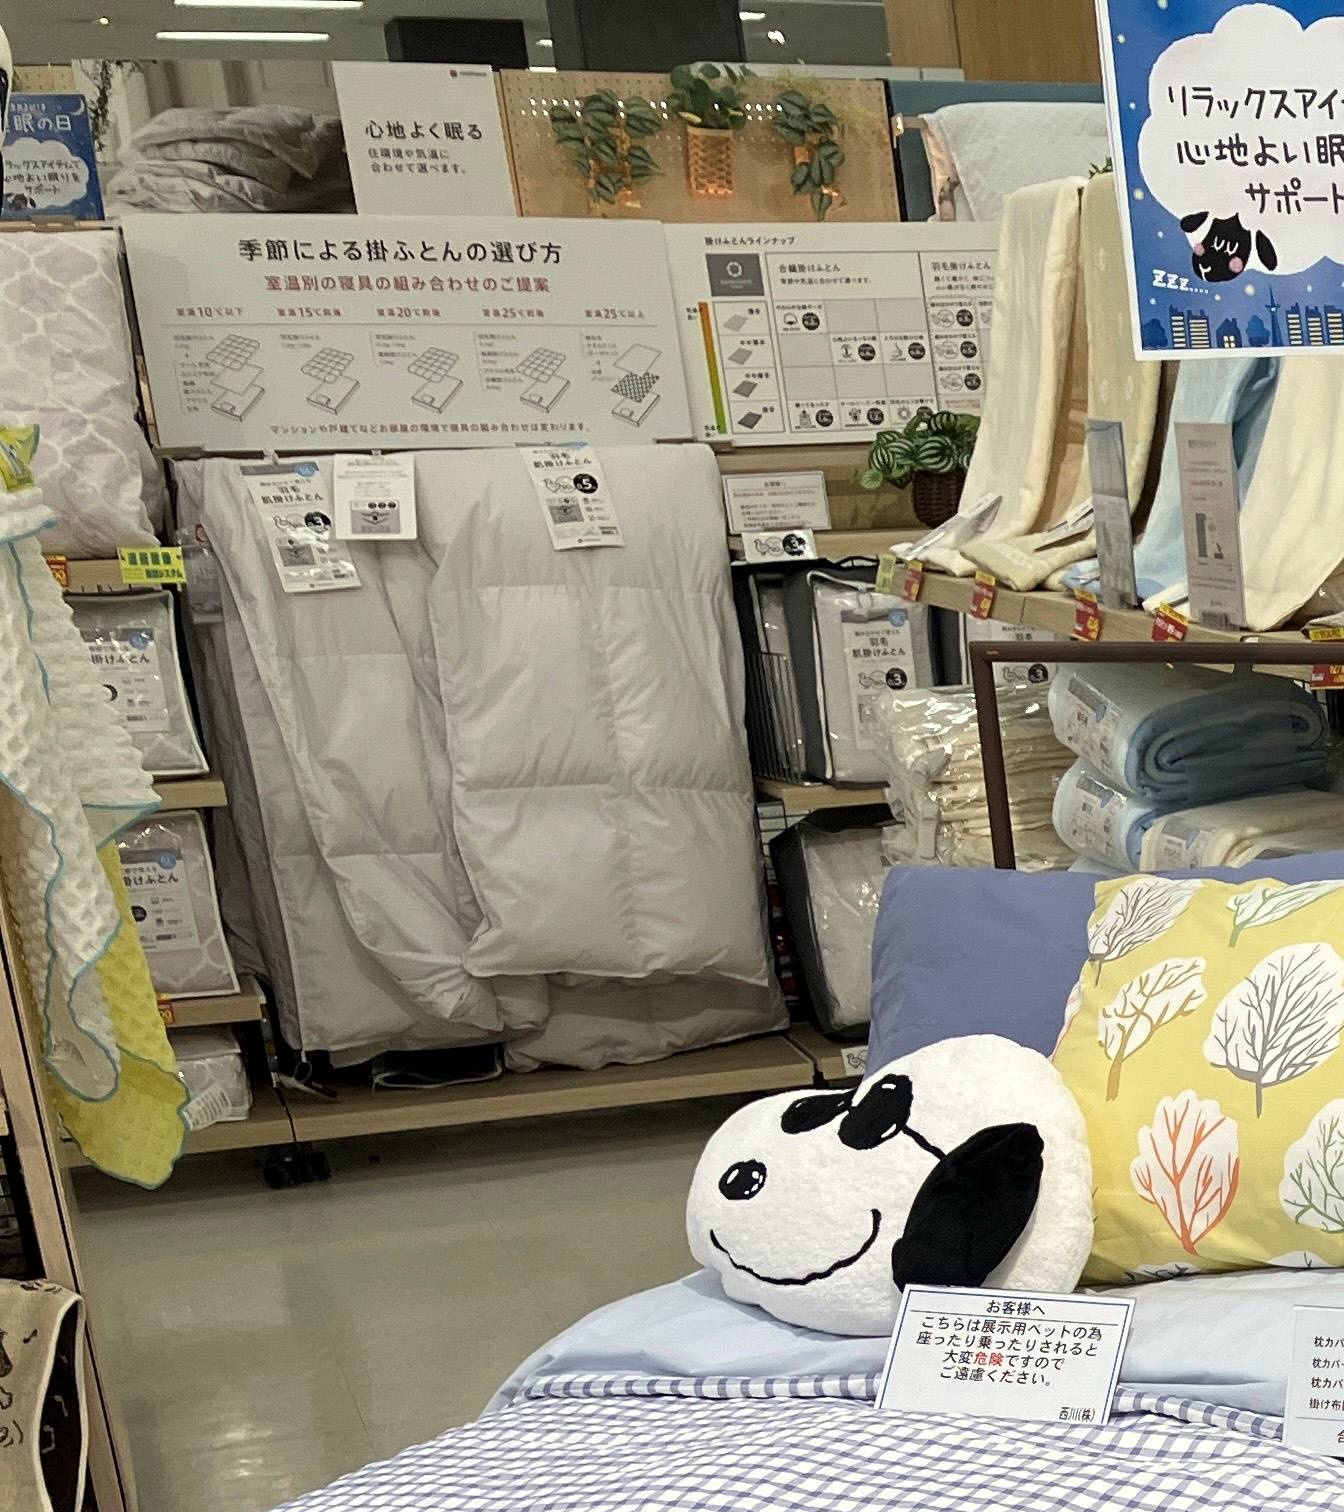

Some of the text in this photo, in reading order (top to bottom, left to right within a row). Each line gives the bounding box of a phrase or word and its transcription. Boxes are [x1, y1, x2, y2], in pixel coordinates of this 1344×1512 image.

[5, 113, 72, 134] 眠の日
[364, 119, 483, 141] 心地よく眠る
[238, 238, 562, 264] 季節による掛ふとんの選び方
[264, 274, 551, 293] 室温別の寝具の組み合わせのご提案
[985, 1300, 1046, 1317] お客様へ
[921, 1314, 1103, 1341] こちらは展示用ベットの為
[915, 1330, 1099, 1357] 座ったり乗ったりされると
[942, 1349, 1066, 1371] 大変危険ですので
[937, 1363, 1053, 1389] ご遠慮ください。
